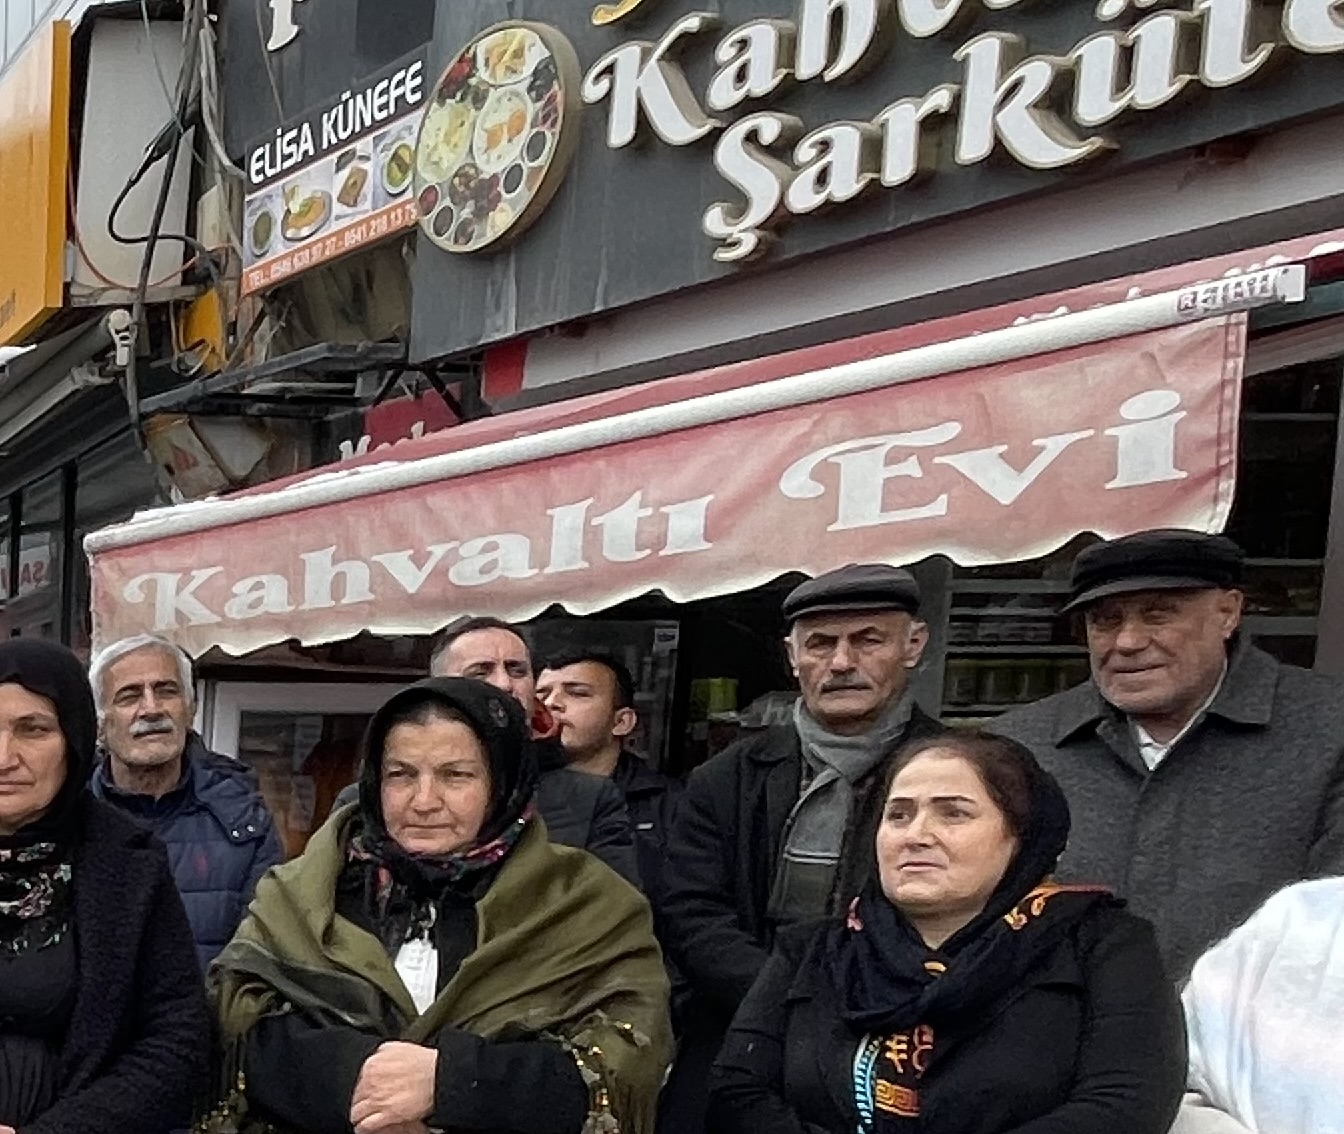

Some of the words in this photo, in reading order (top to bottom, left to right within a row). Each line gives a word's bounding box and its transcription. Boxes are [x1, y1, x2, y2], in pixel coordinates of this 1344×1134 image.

[250, 122, 315, 184] ELİSA
[322, 60, 422, 150] KÜNEFE
[122, 489, 715, 633] Kahvaltı
[778, 389, 1189, 532] Evi
